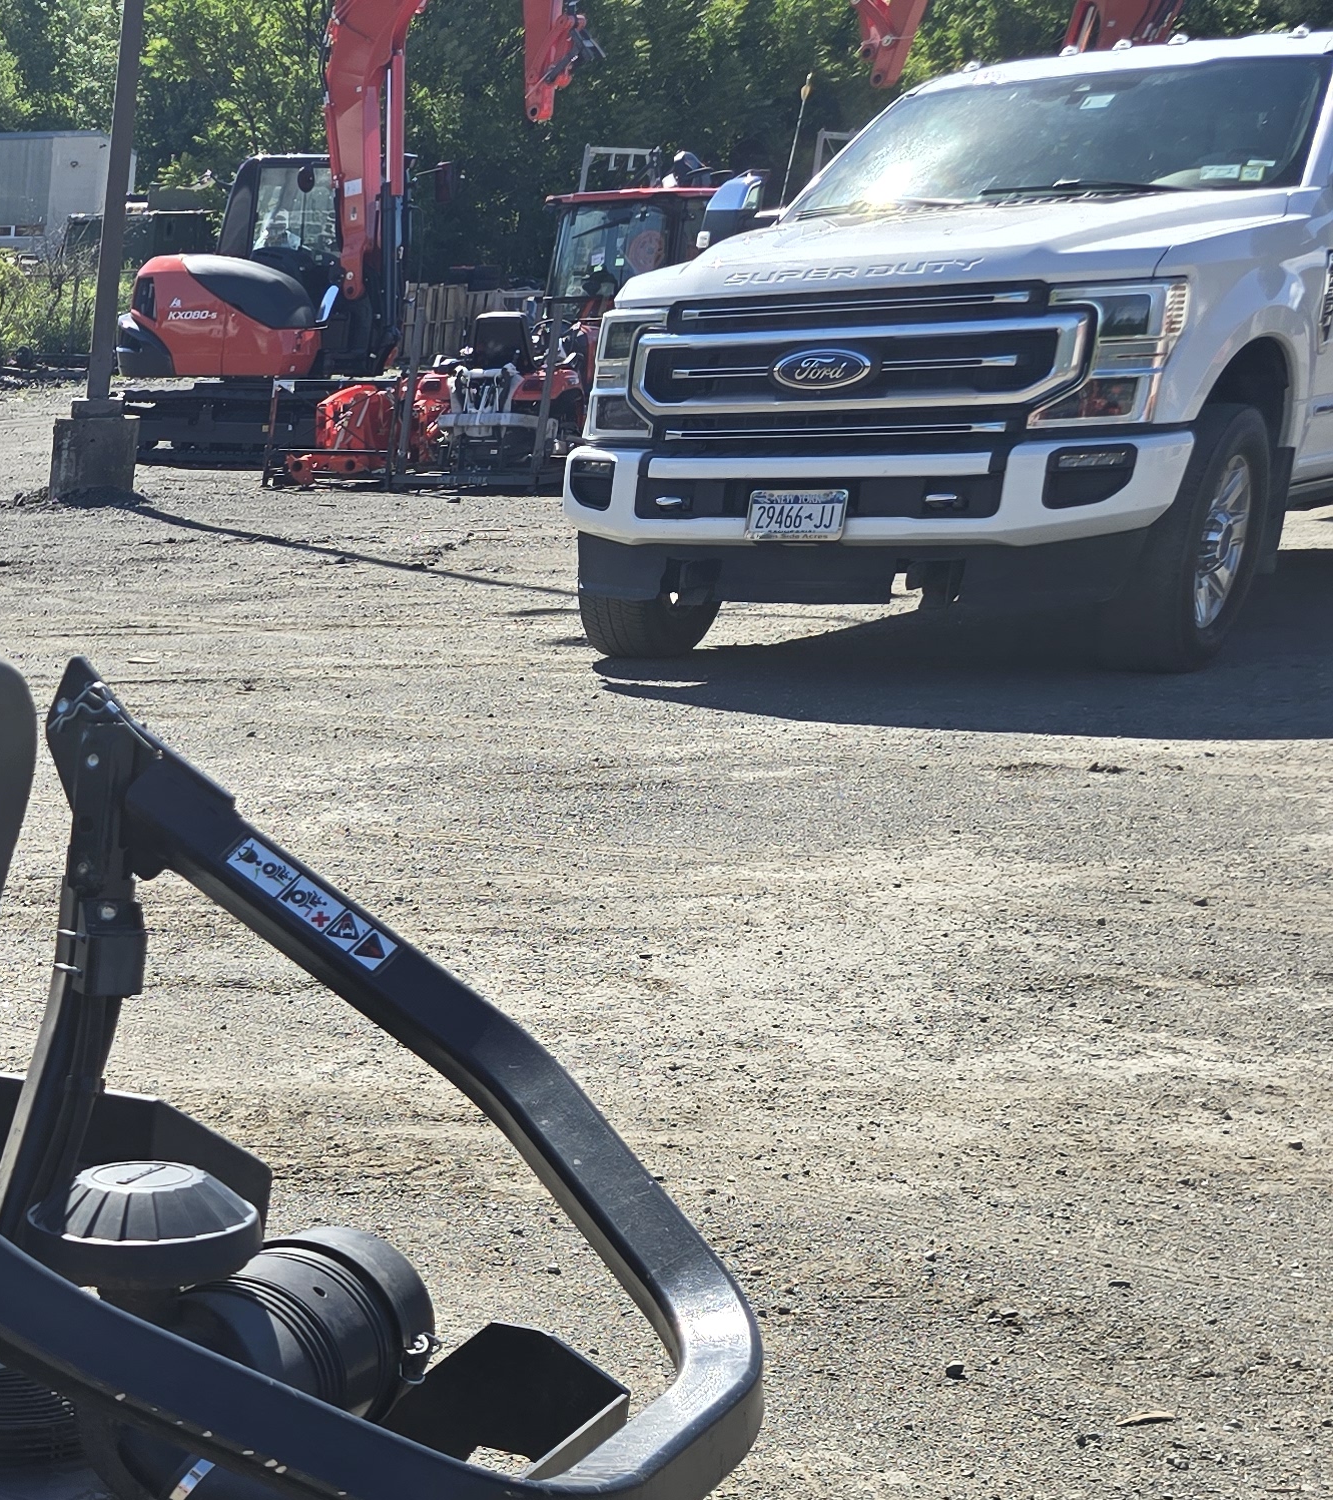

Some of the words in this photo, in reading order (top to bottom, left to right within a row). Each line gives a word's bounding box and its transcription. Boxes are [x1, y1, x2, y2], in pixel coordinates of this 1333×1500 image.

[723, 265, 859, 286] SUPER
[864, 257, 985, 278] DUTY
[794, 357, 848, 381] Ford
[755, 505, 804, 529] 29466
[813, 504, 835, 529] JJ
